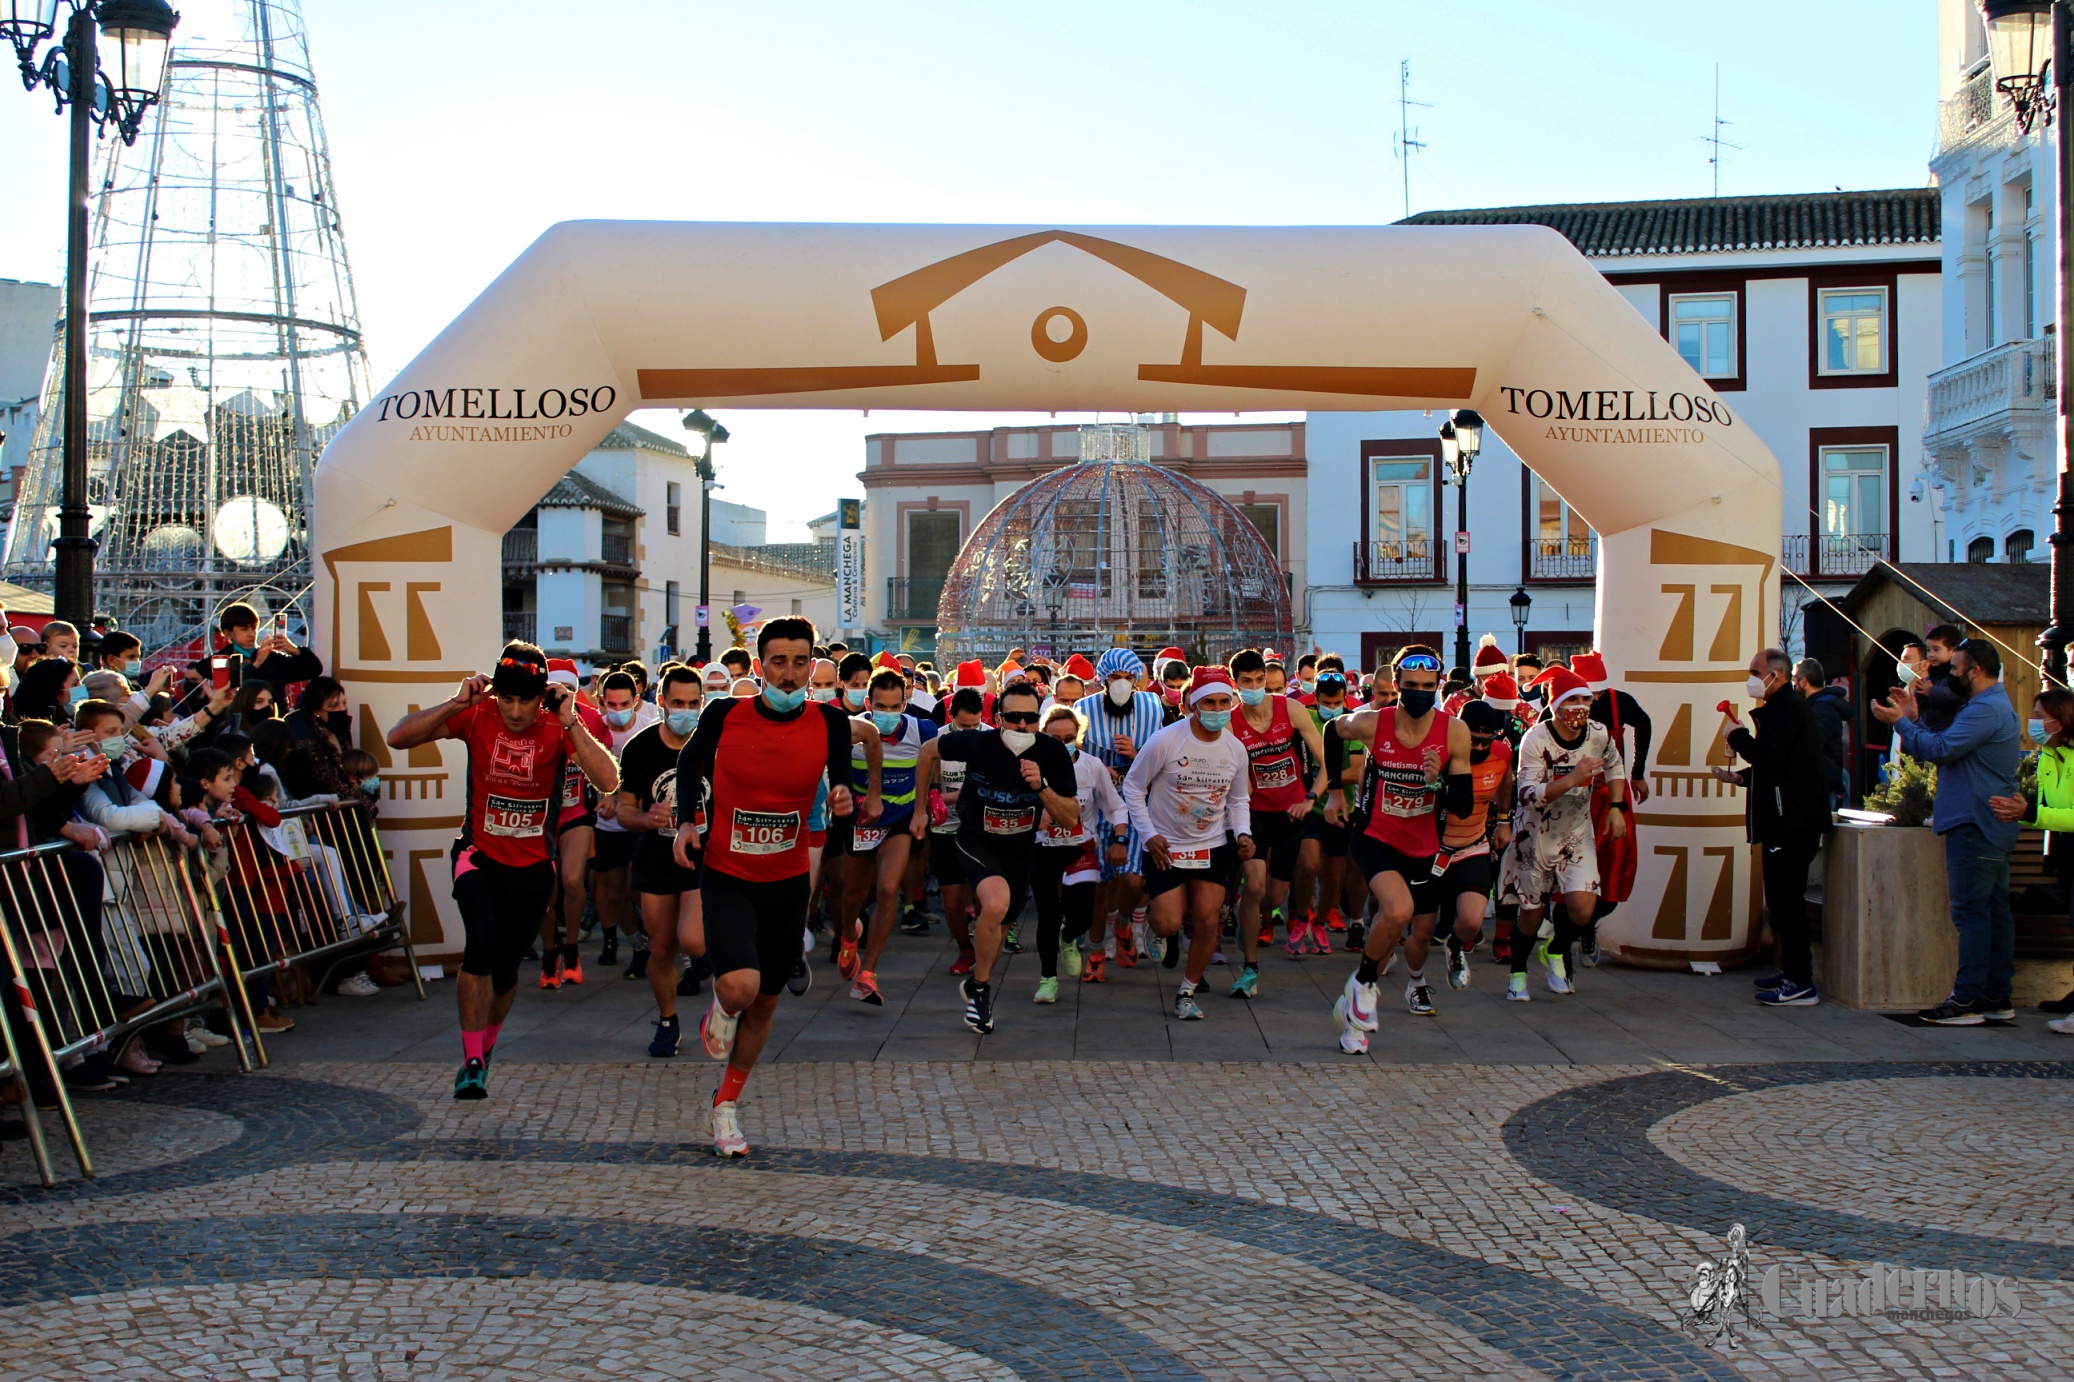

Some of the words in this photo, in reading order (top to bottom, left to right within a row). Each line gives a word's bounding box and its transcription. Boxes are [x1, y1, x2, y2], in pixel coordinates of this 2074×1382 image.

[377, 385, 616, 422] TOMELLOSO
[1500, 386, 1732, 426] TOMELLOSO
[409, 424, 572, 442] AYUNTAMIENTO
[1545, 426, 1704, 444] AYUNTAMIENTO
[843, 535, 852, 604] MANCHEGA
[843, 605, 852, 623] LA
[1382, 760, 1418, 769] atletismo
[1263, 769, 1288, 782] 228
[1378, 768, 1426, 782] MANCHATH
[1393, 795, 1424, 809] 279
[499, 811, 533, 828] 105
[999, 818, 1019, 828] 35
[746, 826, 784, 844] 106
